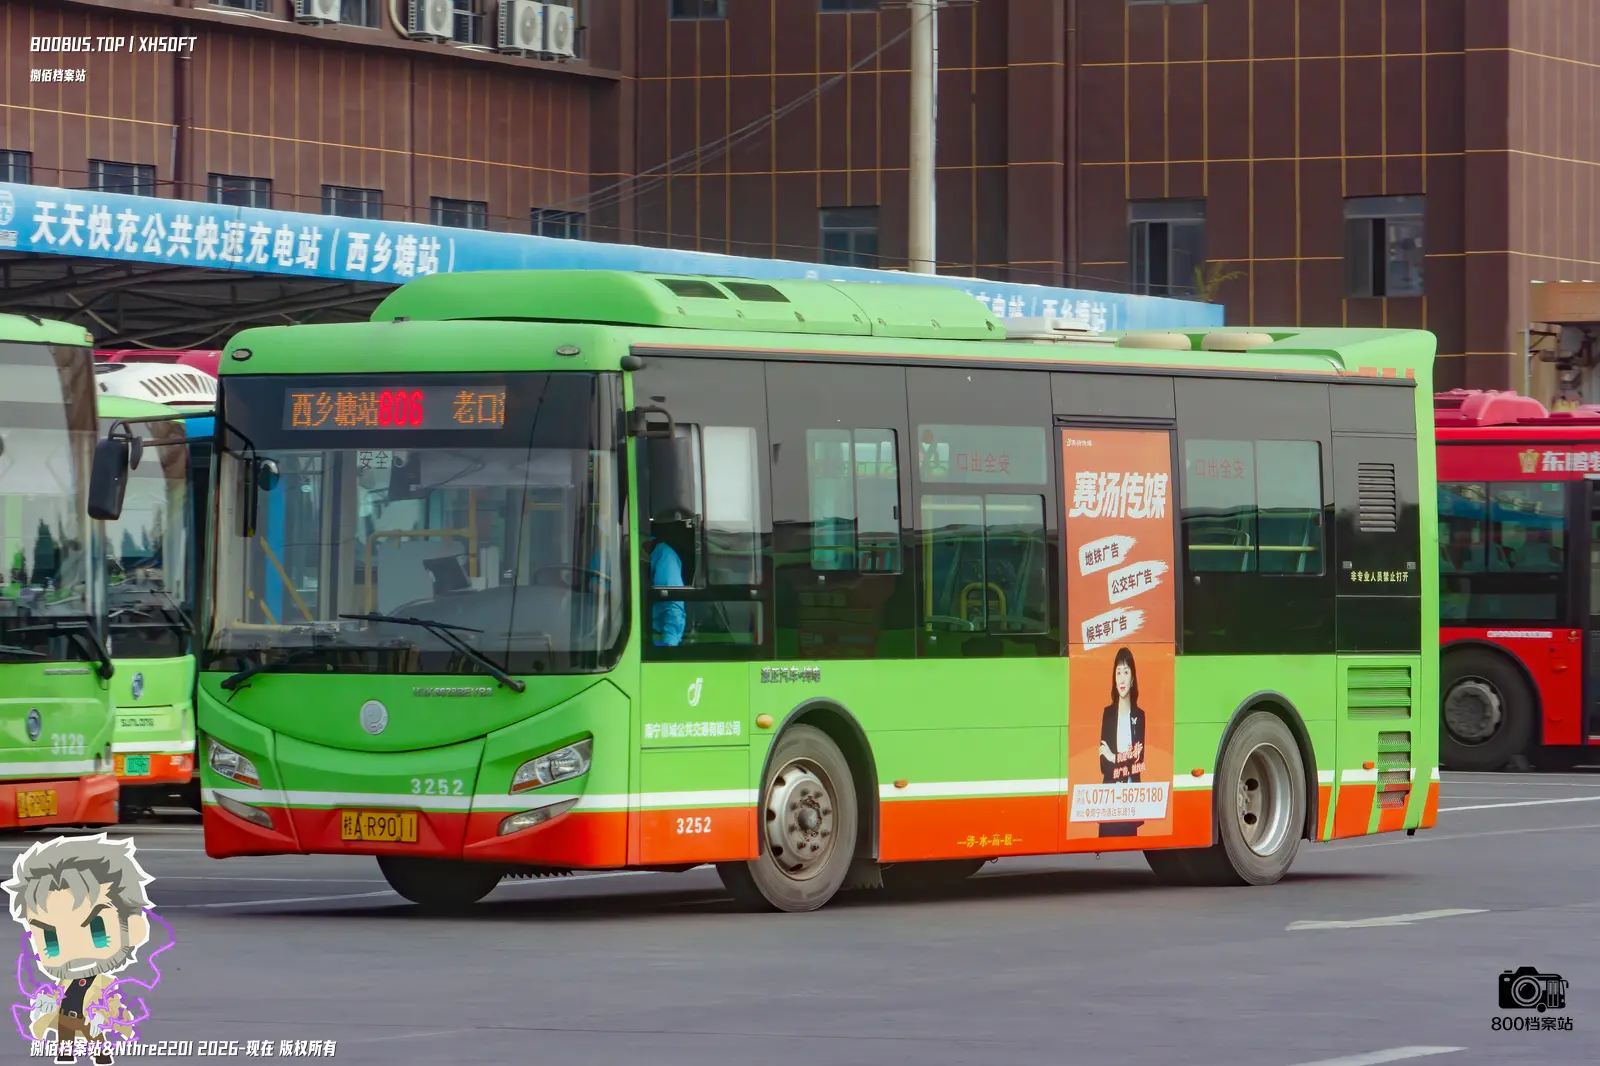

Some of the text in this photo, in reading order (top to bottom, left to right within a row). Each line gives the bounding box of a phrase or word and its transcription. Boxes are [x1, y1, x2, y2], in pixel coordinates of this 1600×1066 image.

[1068, 471, 1168, 519] 赛扬传媒
[1084, 542, 1119, 567] 地铁广告
[1111, 568, 1153, 595] 公交车广告
[1350, 570, 1409, 582] 非专业人员禁止打开
[1086, 614, 1128, 643] 候车亭广告
[411, 778, 464, 796] 3252
[1092, 787, 1164, 805] 0771-5675180
[676, 816, 712, 835] 3252
